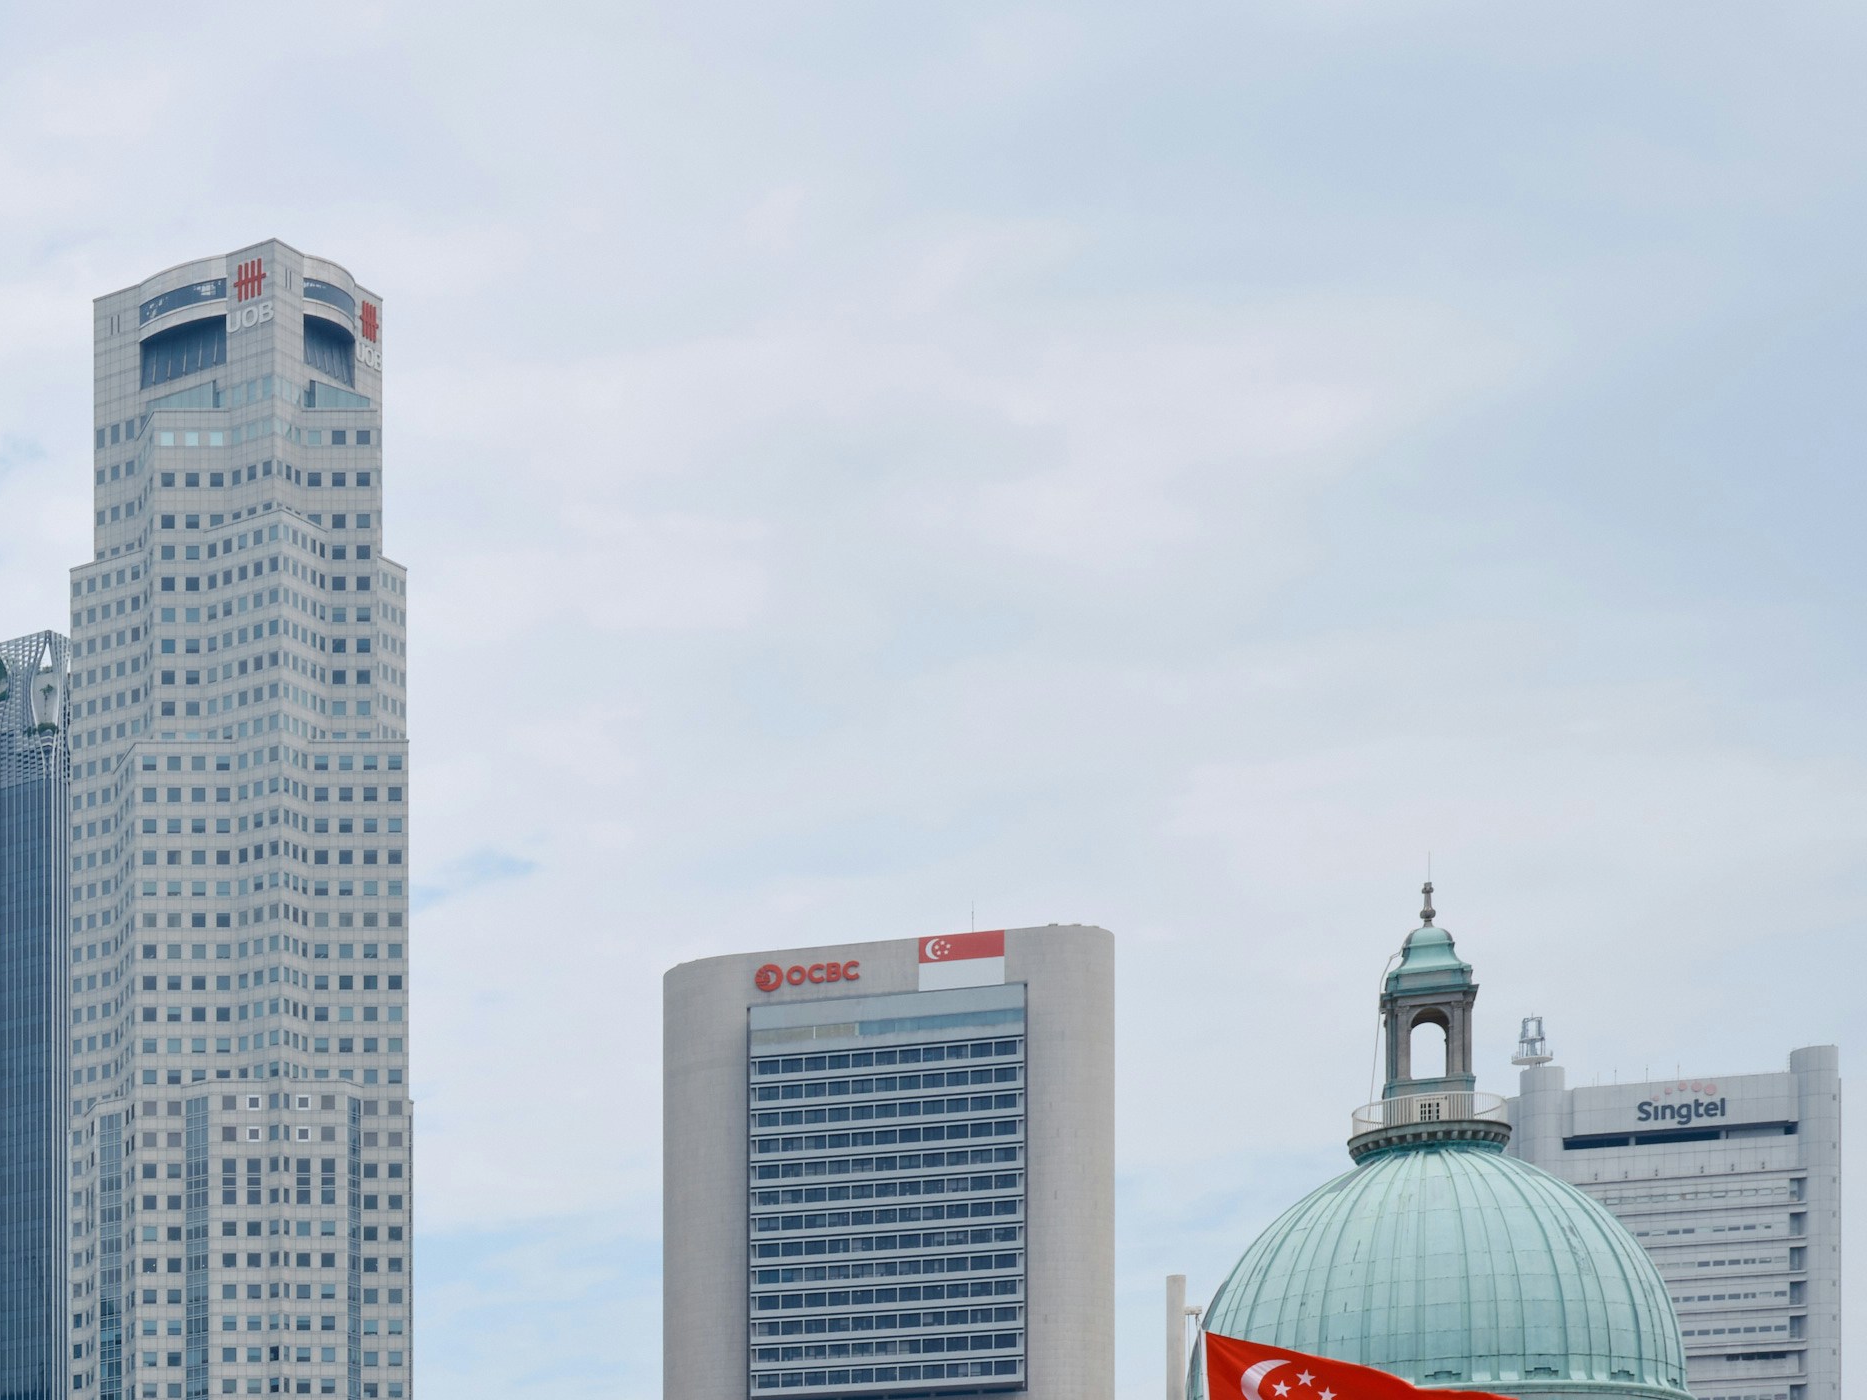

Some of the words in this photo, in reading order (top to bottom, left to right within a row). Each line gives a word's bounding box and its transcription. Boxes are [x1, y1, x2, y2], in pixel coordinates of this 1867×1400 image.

[226, 301, 274, 333] UOB
[356, 340, 383, 371] UOB
[786, 960, 860, 983] OCBC
[1637, 1097, 1726, 1125] Singtel
